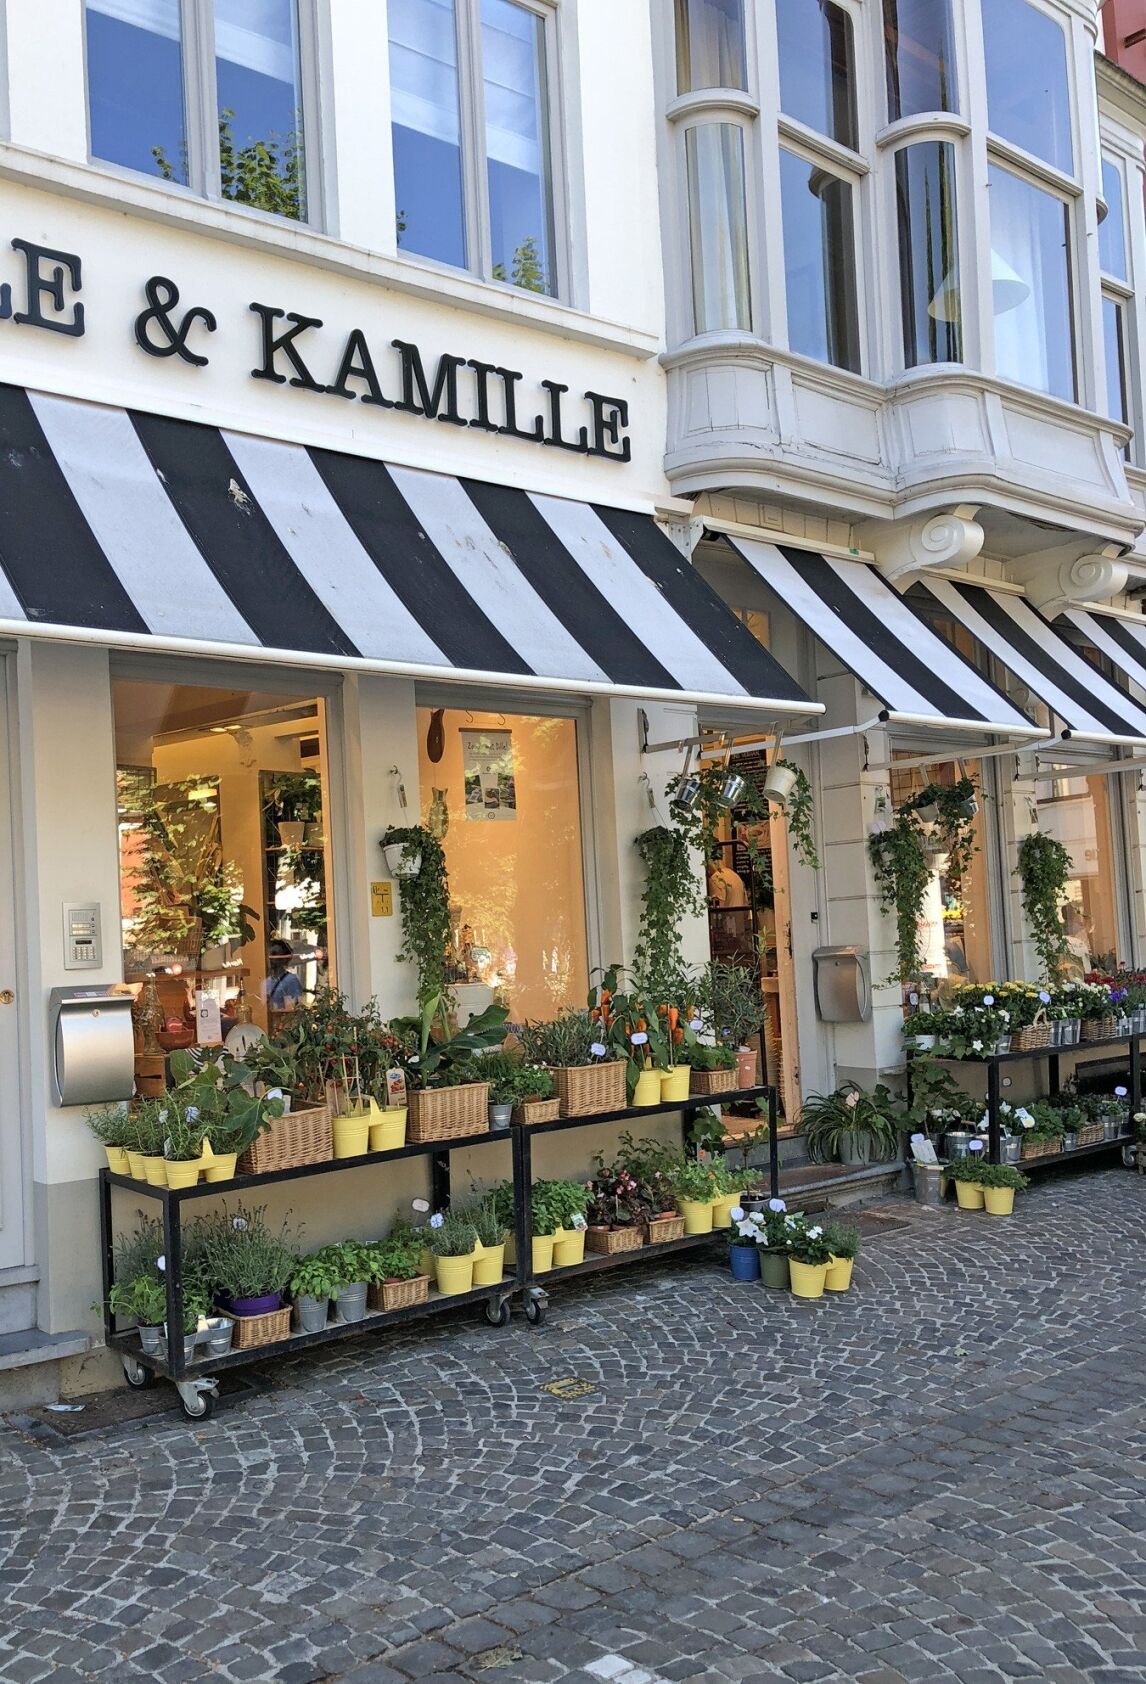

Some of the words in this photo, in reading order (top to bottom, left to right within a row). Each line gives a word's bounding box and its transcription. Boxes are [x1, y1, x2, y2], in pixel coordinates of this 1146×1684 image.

[0, 238, 85, 337] E
[135, 276, 217, 366] &
[249, 302, 632, 463] KAMILLE
